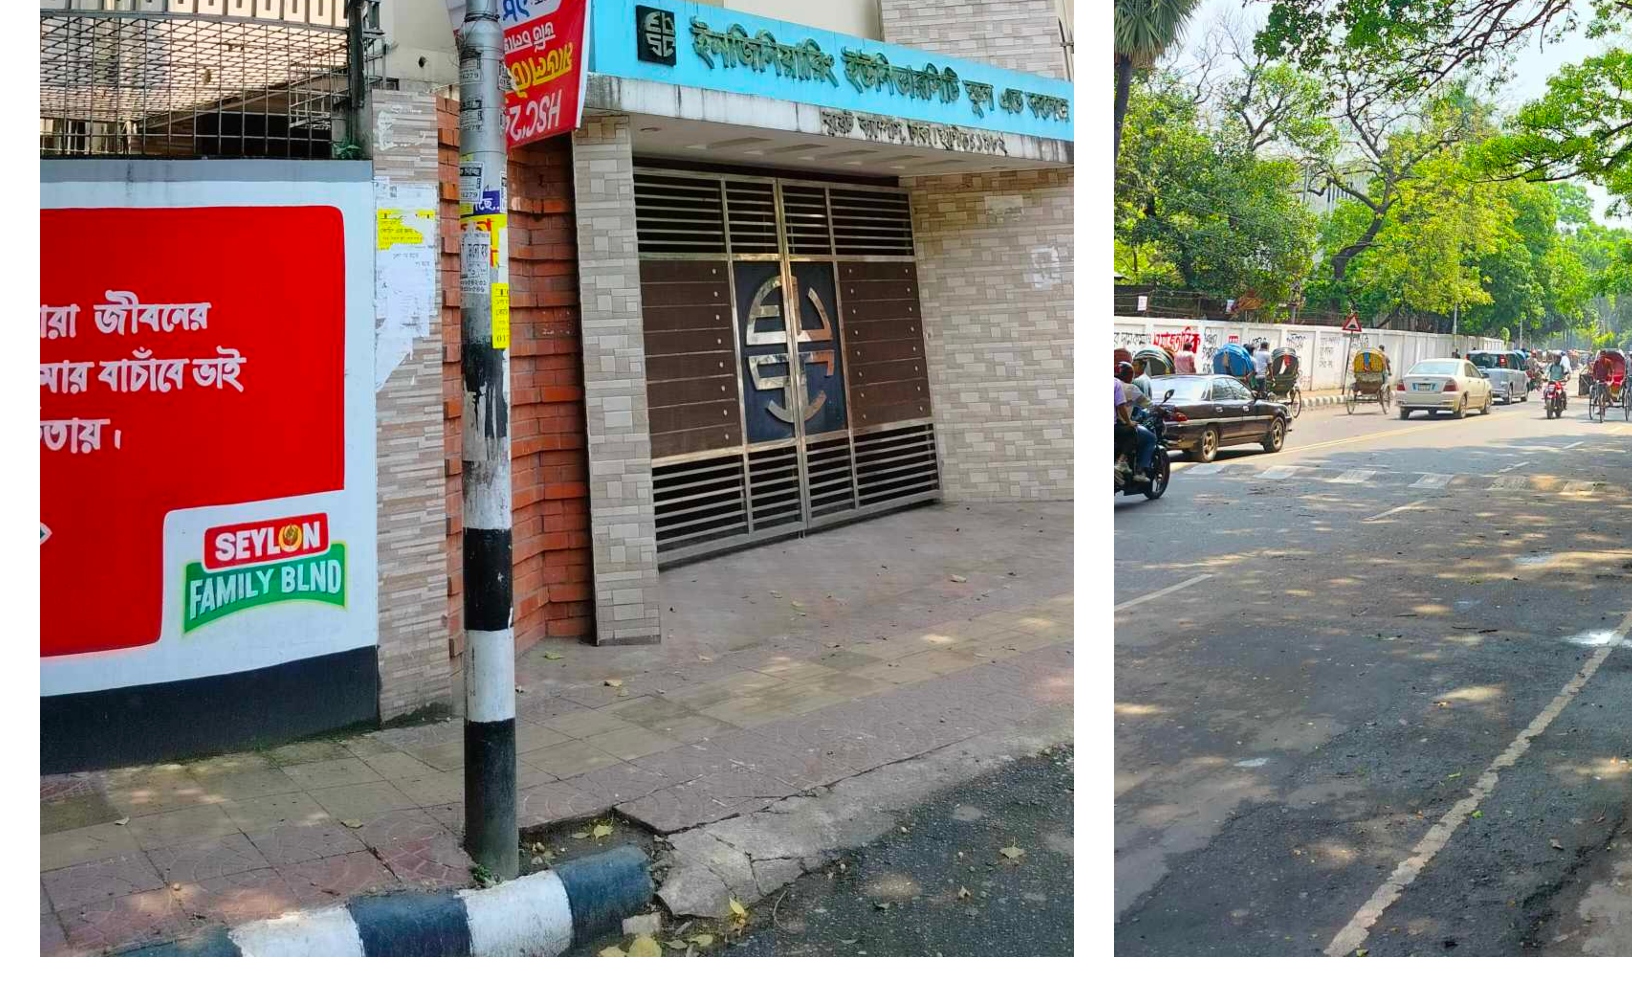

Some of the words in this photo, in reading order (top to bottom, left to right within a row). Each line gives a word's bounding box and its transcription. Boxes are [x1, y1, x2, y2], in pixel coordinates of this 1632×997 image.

[93, 289, 212, 336] জীবনের
[192, 345, 247, 393] ভাই
[214, 520, 322, 562] SEYLON
[189, 568, 275, 621] FAMILY
[281, 559, 342, 594] BLND
